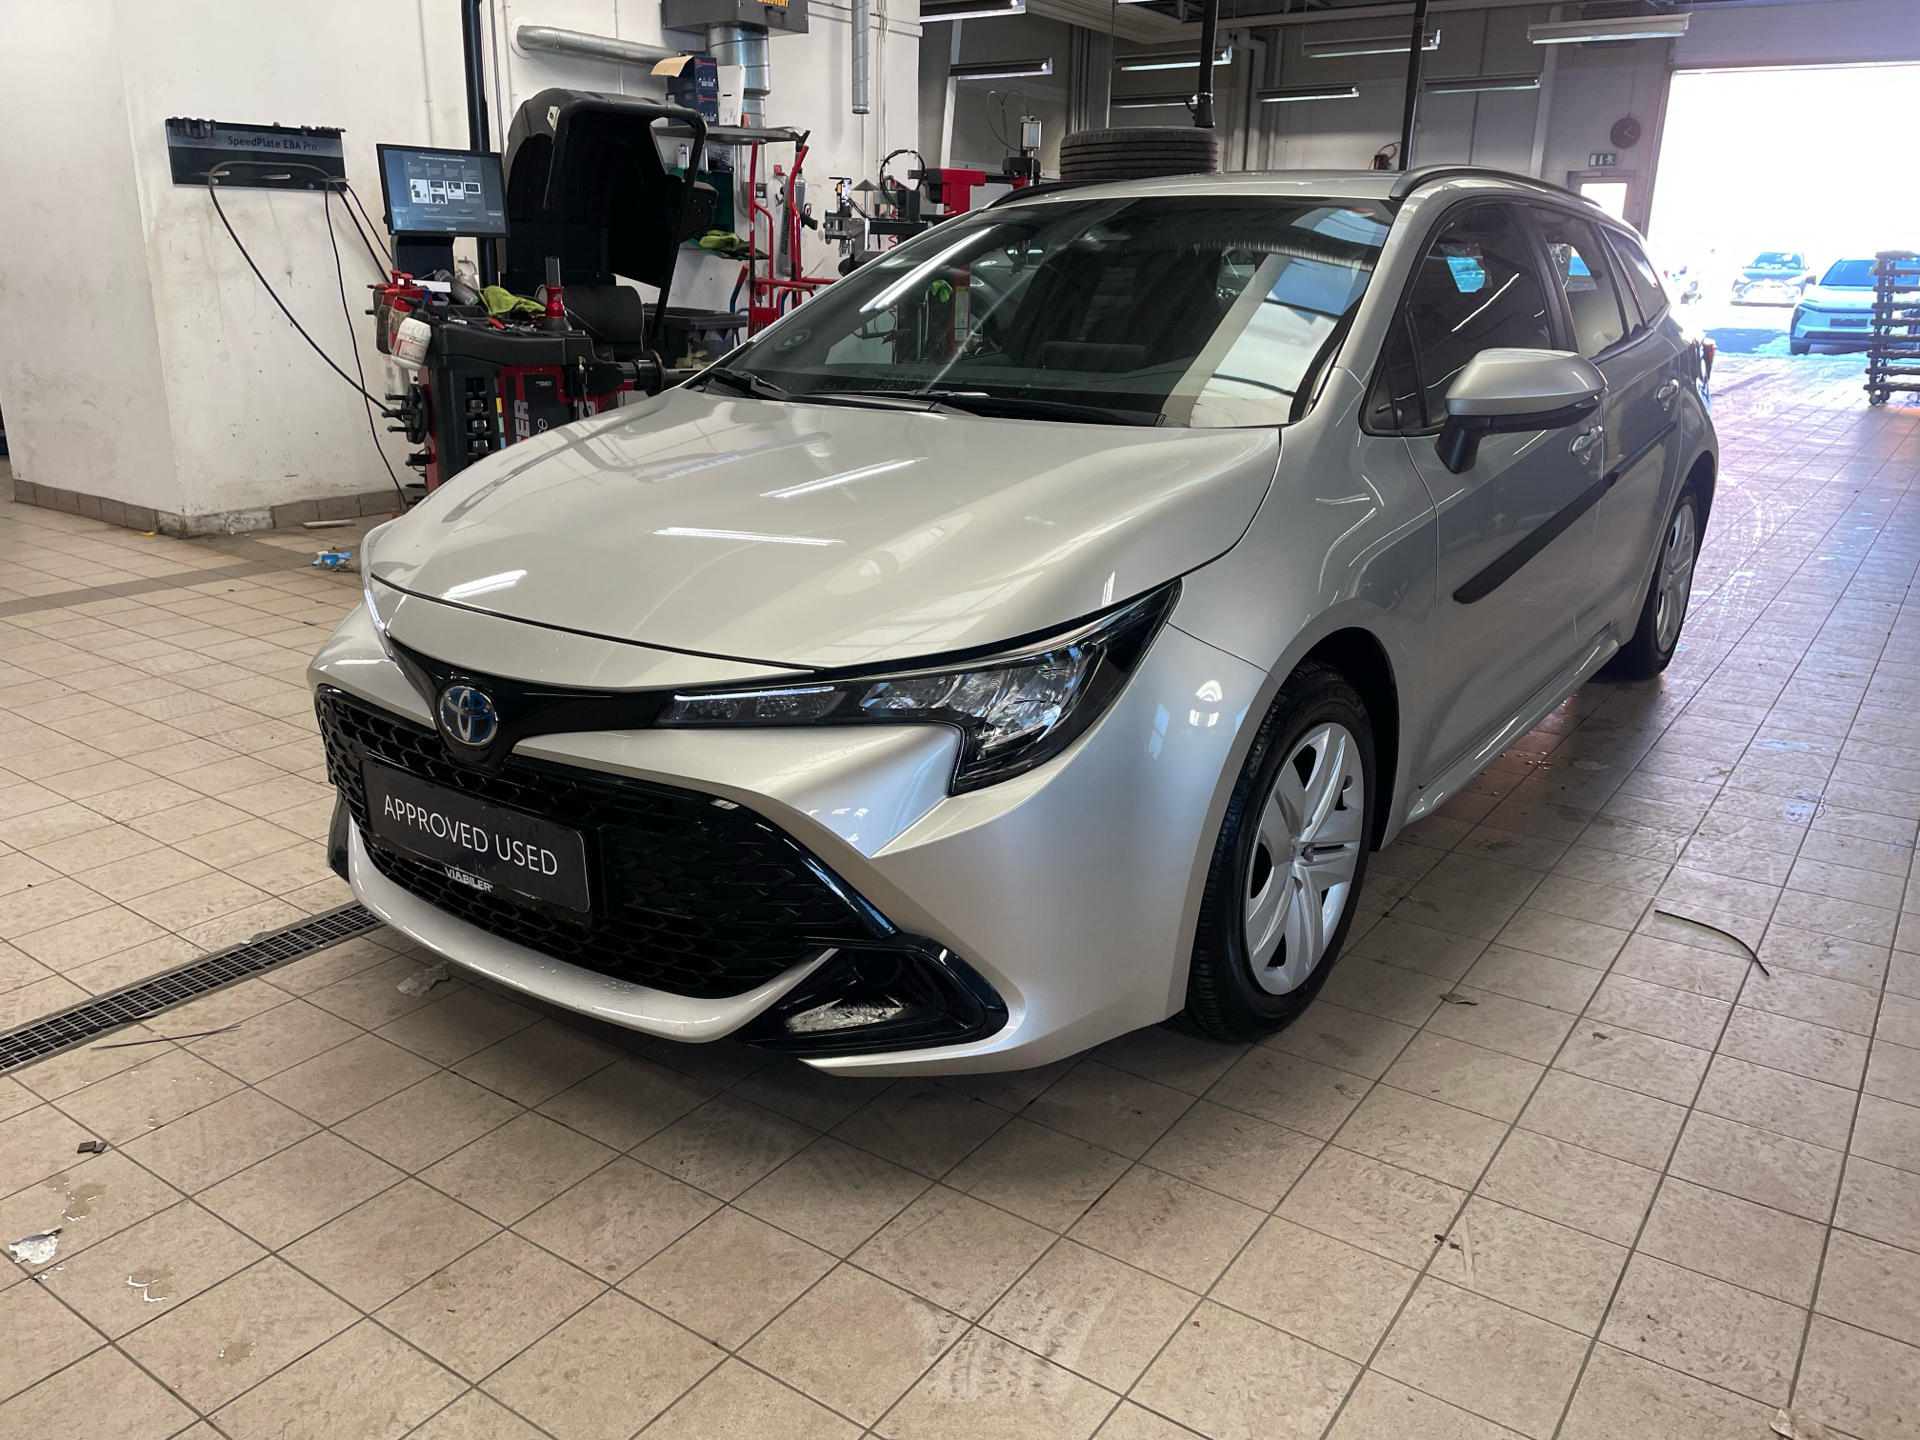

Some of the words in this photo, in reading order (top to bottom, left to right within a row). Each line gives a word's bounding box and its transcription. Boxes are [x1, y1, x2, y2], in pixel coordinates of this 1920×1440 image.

[228, 135, 281, 149] SpeedPlate
[283, 139, 302, 150] EBA
[303, 140, 318, 151] Pro
[384, 794, 489, 853] APPROVED
[495, 833, 558, 876] USED
